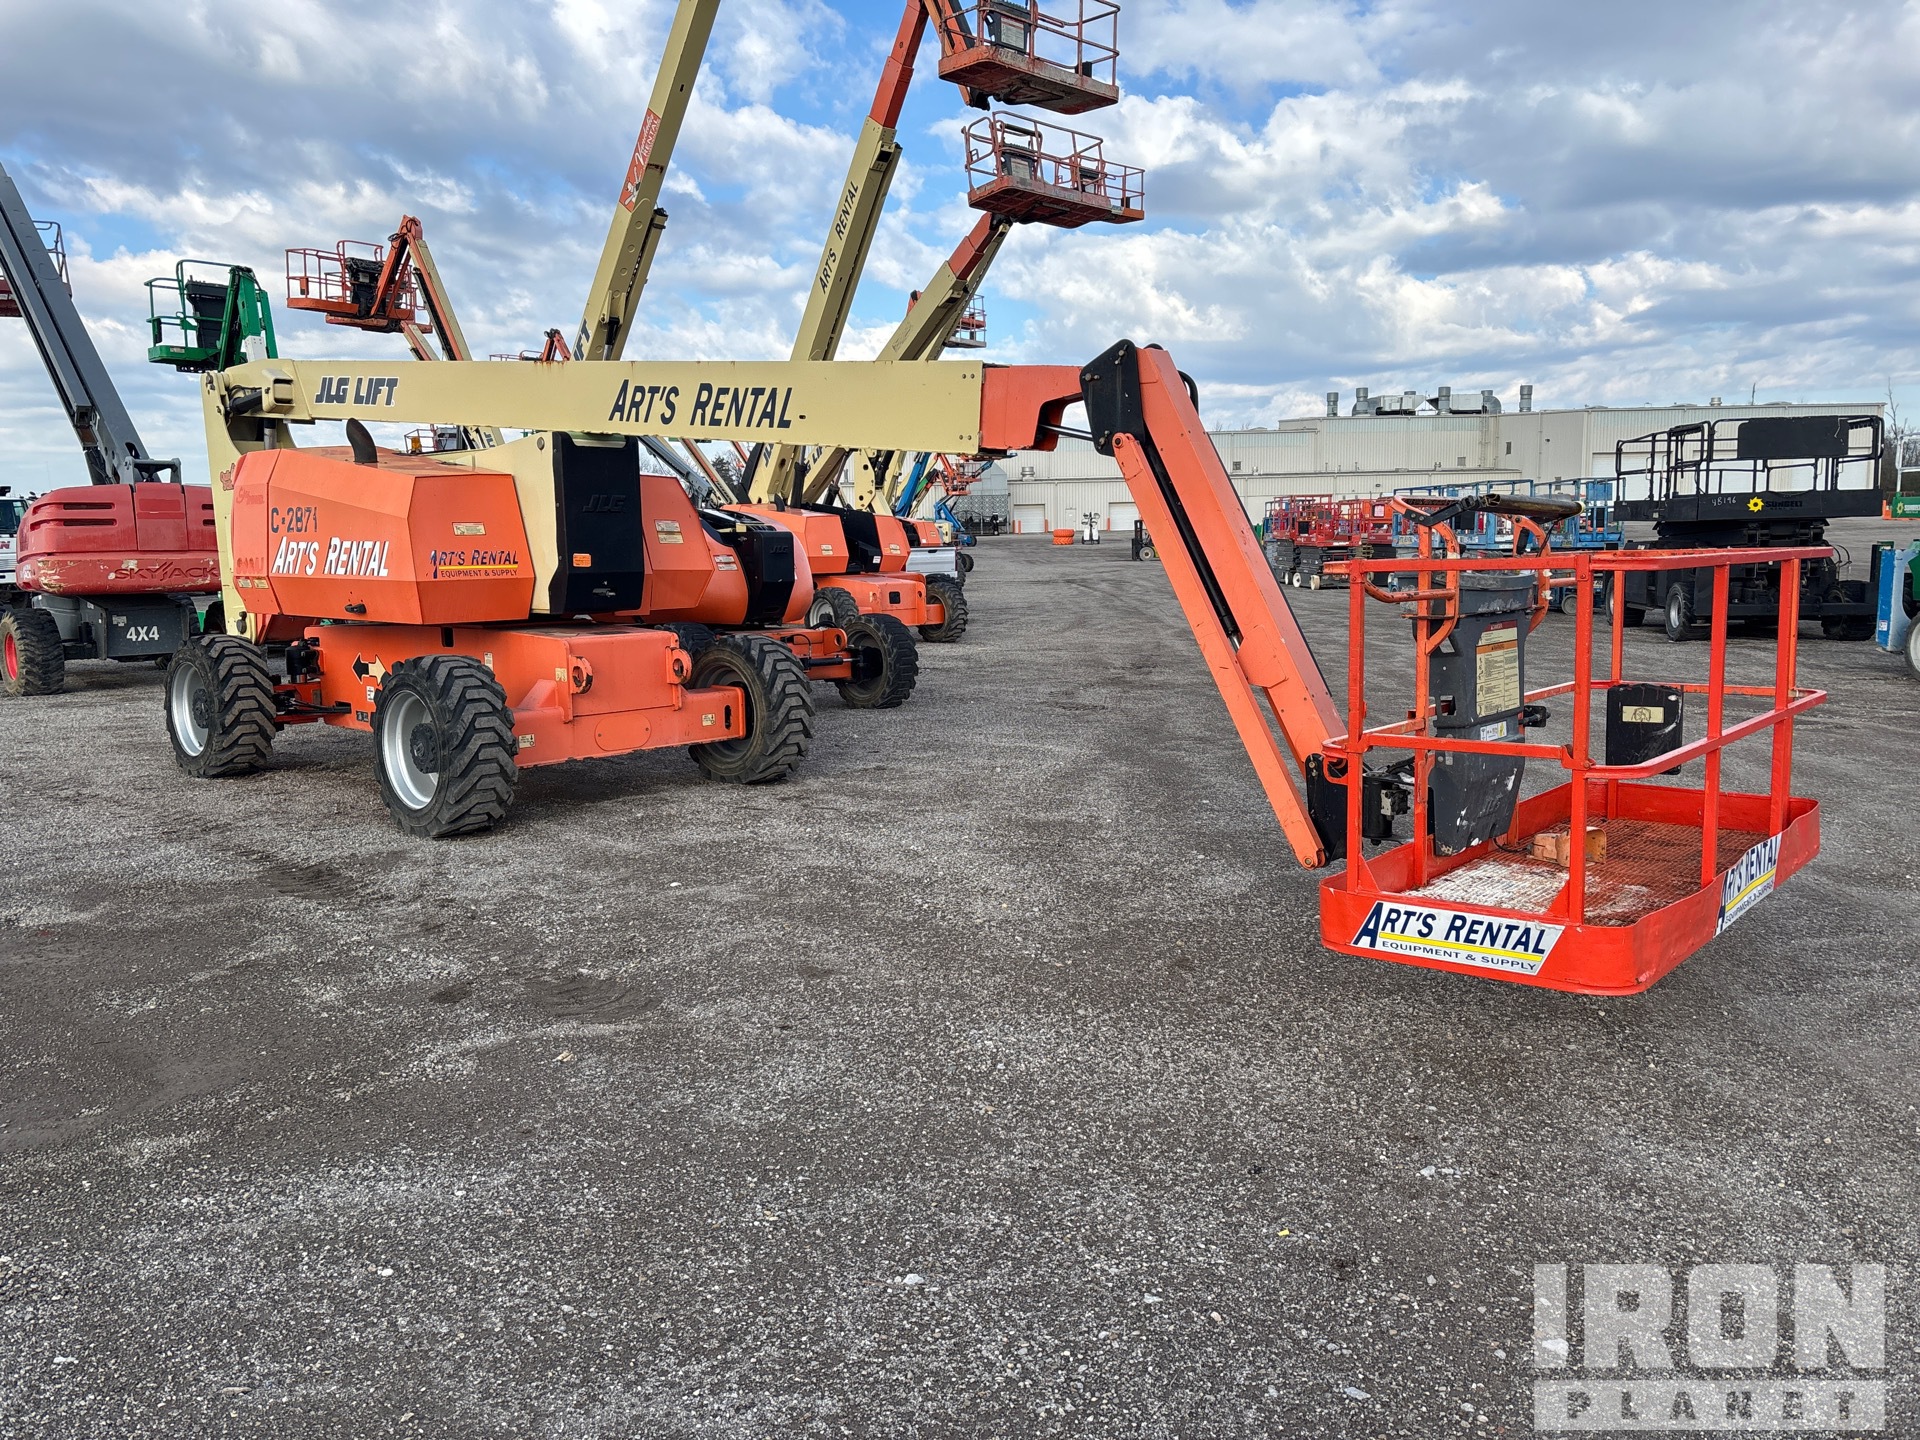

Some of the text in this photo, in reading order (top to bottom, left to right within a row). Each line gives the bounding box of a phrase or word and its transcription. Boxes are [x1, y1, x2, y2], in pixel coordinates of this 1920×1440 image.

[643, 118, 660, 156] RENTAL
[818, 181, 859, 295] ART'S RENTAL
[573, 318, 590, 361] IFT
[314, 376, 399, 406] JLG LIFT
[608, 379, 793, 429] ART'S RENTAL
[271, 506, 318, 533] C-2871
[114, 561, 218, 581] SKYJACK
[271, 536, 320, 576] ART'S
[323, 536, 389, 577] RENTAL
[430, 549, 519, 579] ART'S RENTAL
[441, 569, 518, 578] EQUIPMENT & SUPPLY
[126, 625, 160, 642] 4X4
[1745, 835, 1777, 887] RENTAL
[1353, 902, 1547, 955] ART'S RENTAL
[1382, 940, 1537, 971] EQUIPMENT & SUPPLY
